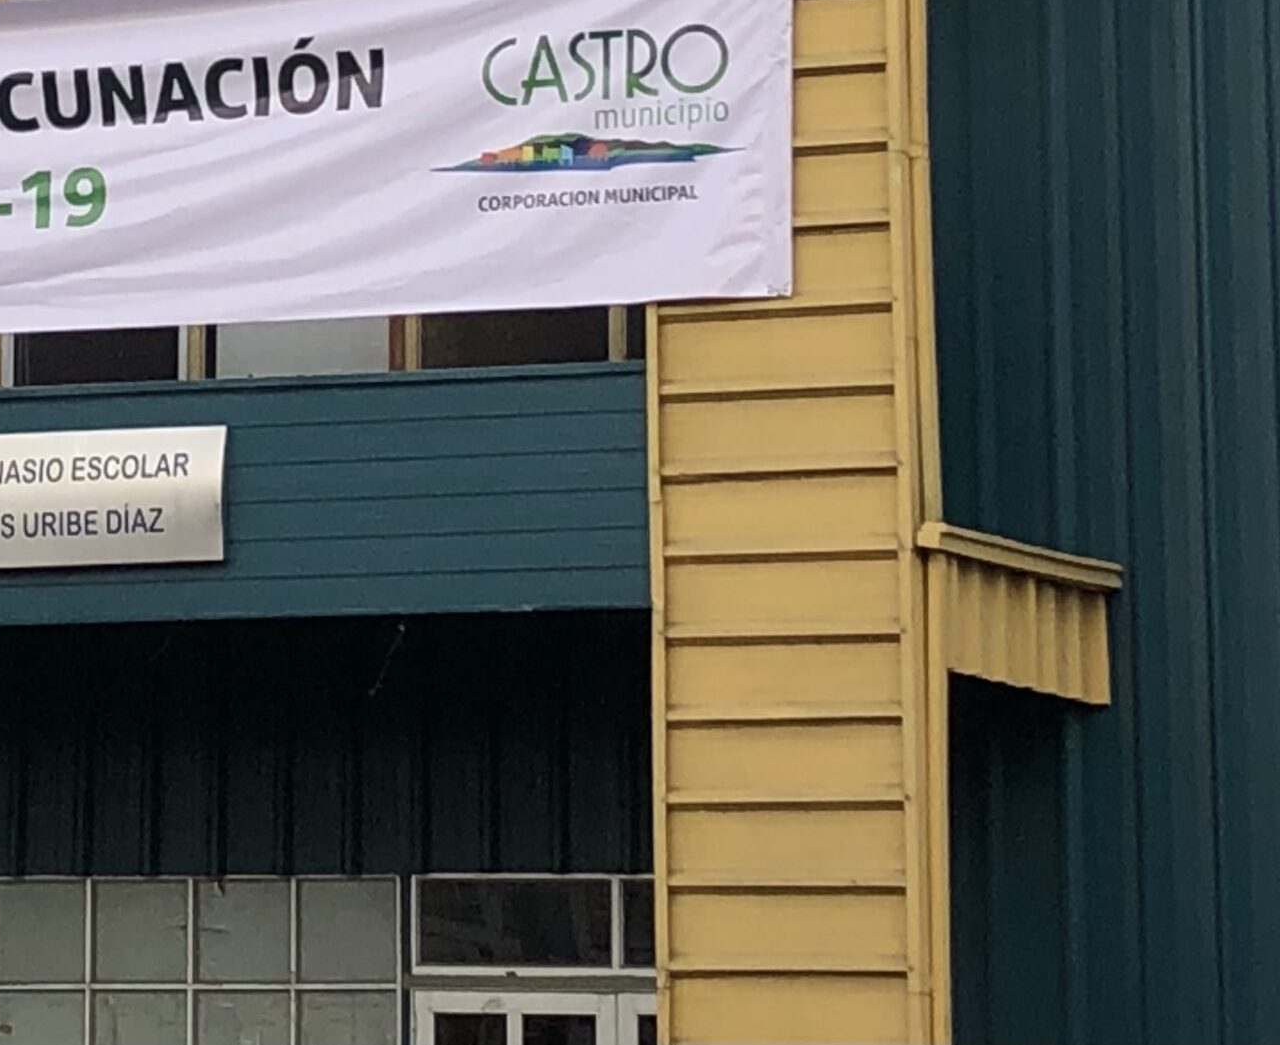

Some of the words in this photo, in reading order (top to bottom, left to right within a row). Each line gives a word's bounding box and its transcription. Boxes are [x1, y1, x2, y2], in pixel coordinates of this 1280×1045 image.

[482, 24, 729, 106] CASTRO
[595, 98, 730, 131] municipio
[478, 190, 600, 212] CORPORACION
[604, 185, 698, 204] MUNICIPAL
[71, 453, 189, 481] ESCOLAR
[23, 510, 98, 538] URIBE
[106, 502, 165, 535] DÍAZ
